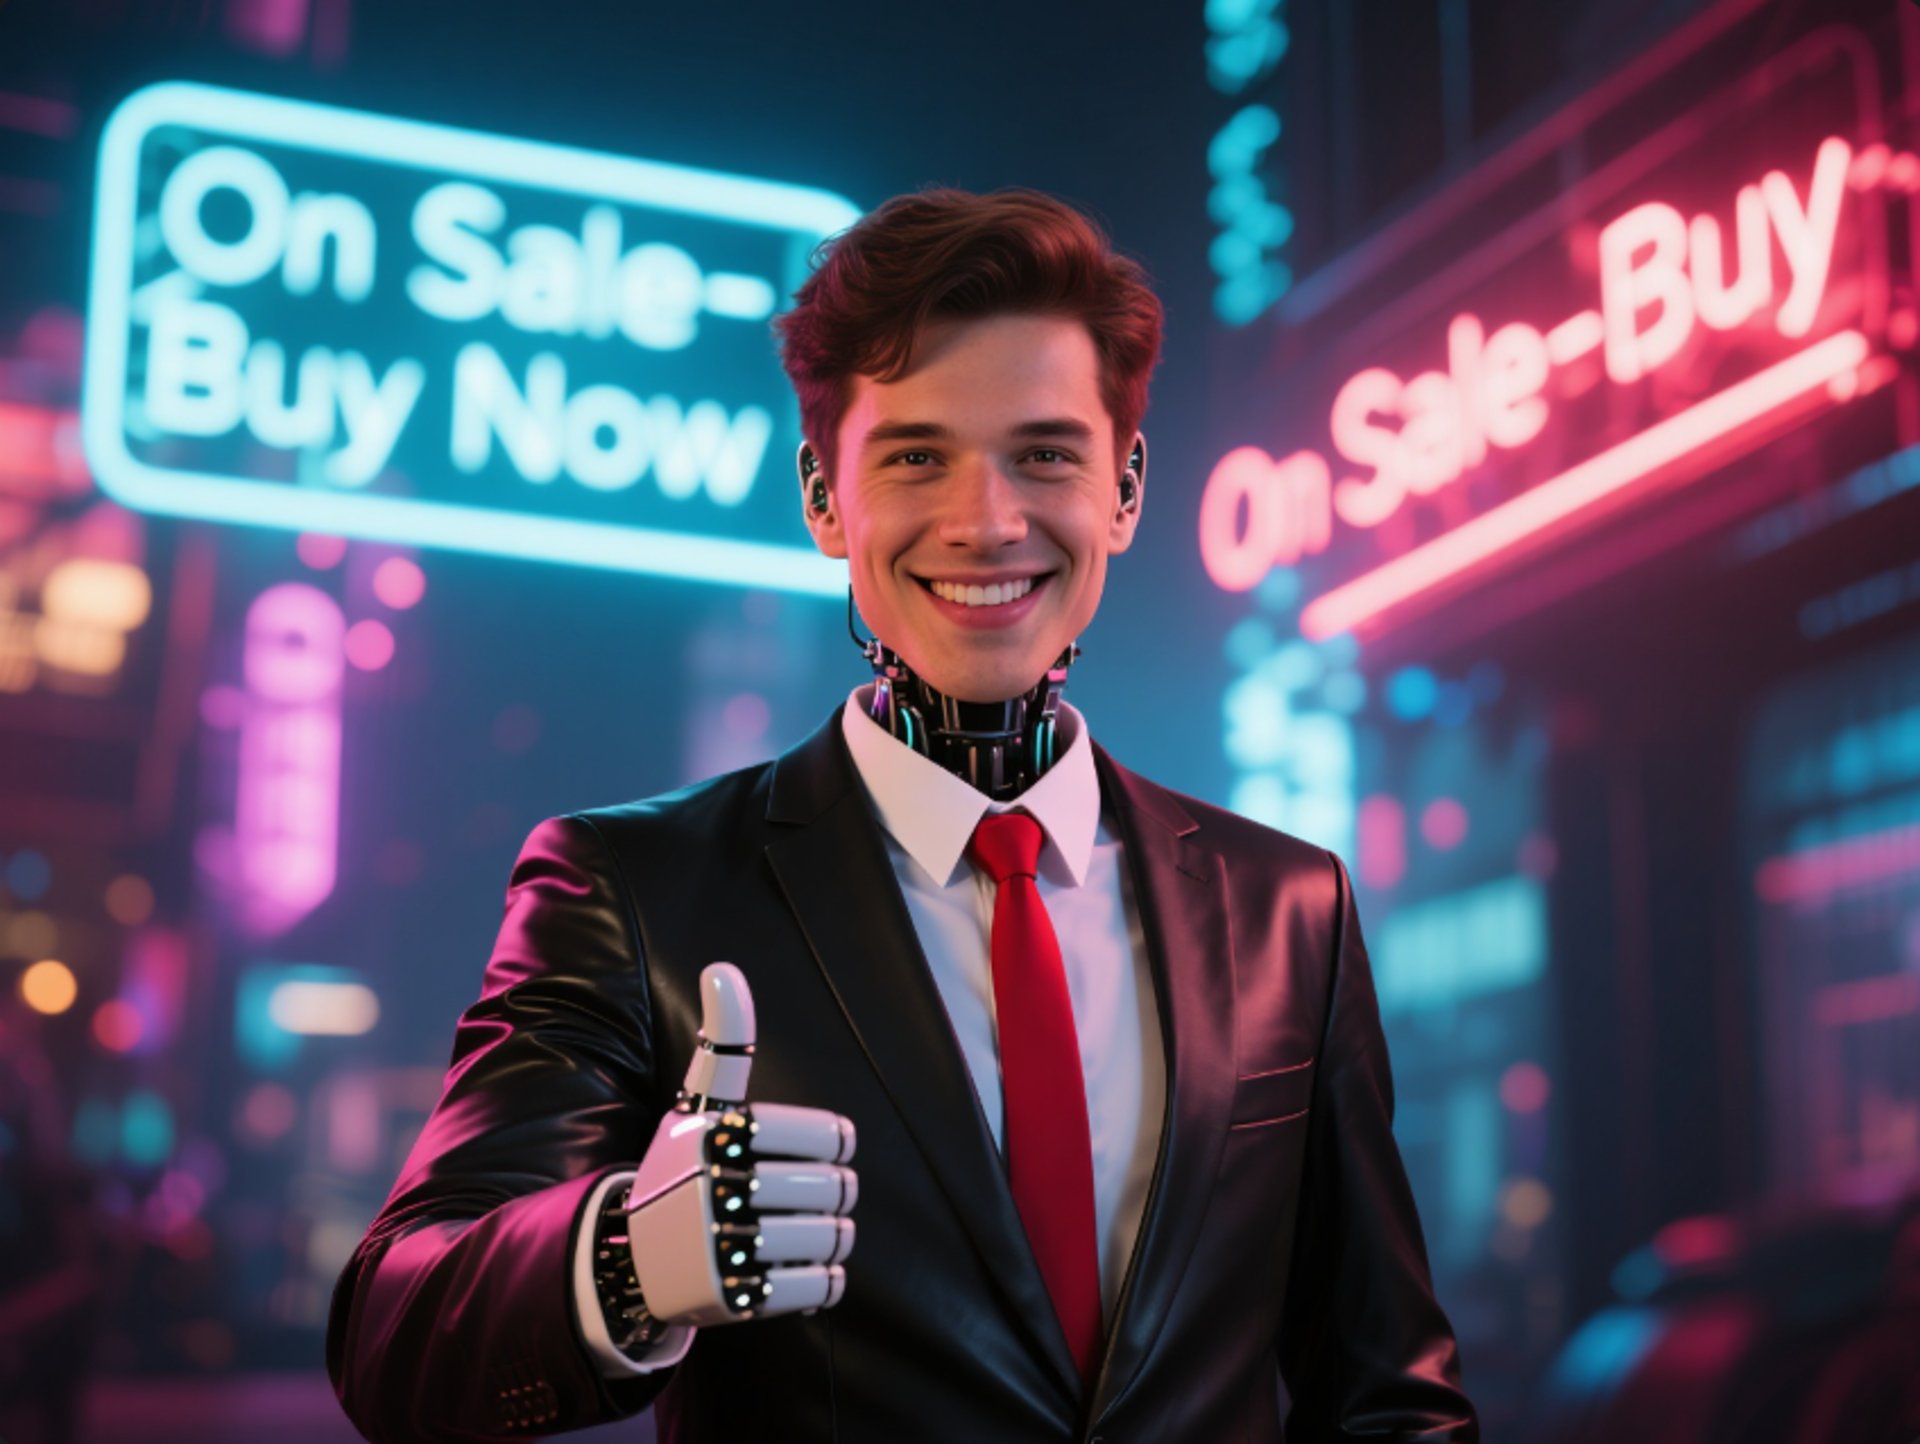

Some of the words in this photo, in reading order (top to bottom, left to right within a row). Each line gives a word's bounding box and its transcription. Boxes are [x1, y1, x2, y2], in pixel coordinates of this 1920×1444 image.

[159, 144, 377, 304] On
[405, 181, 776, 351] Sale-
[144, 299, 426, 490] Buy
[449, 341, 774, 507] Now
[1199, 445, 1332, 592] On
